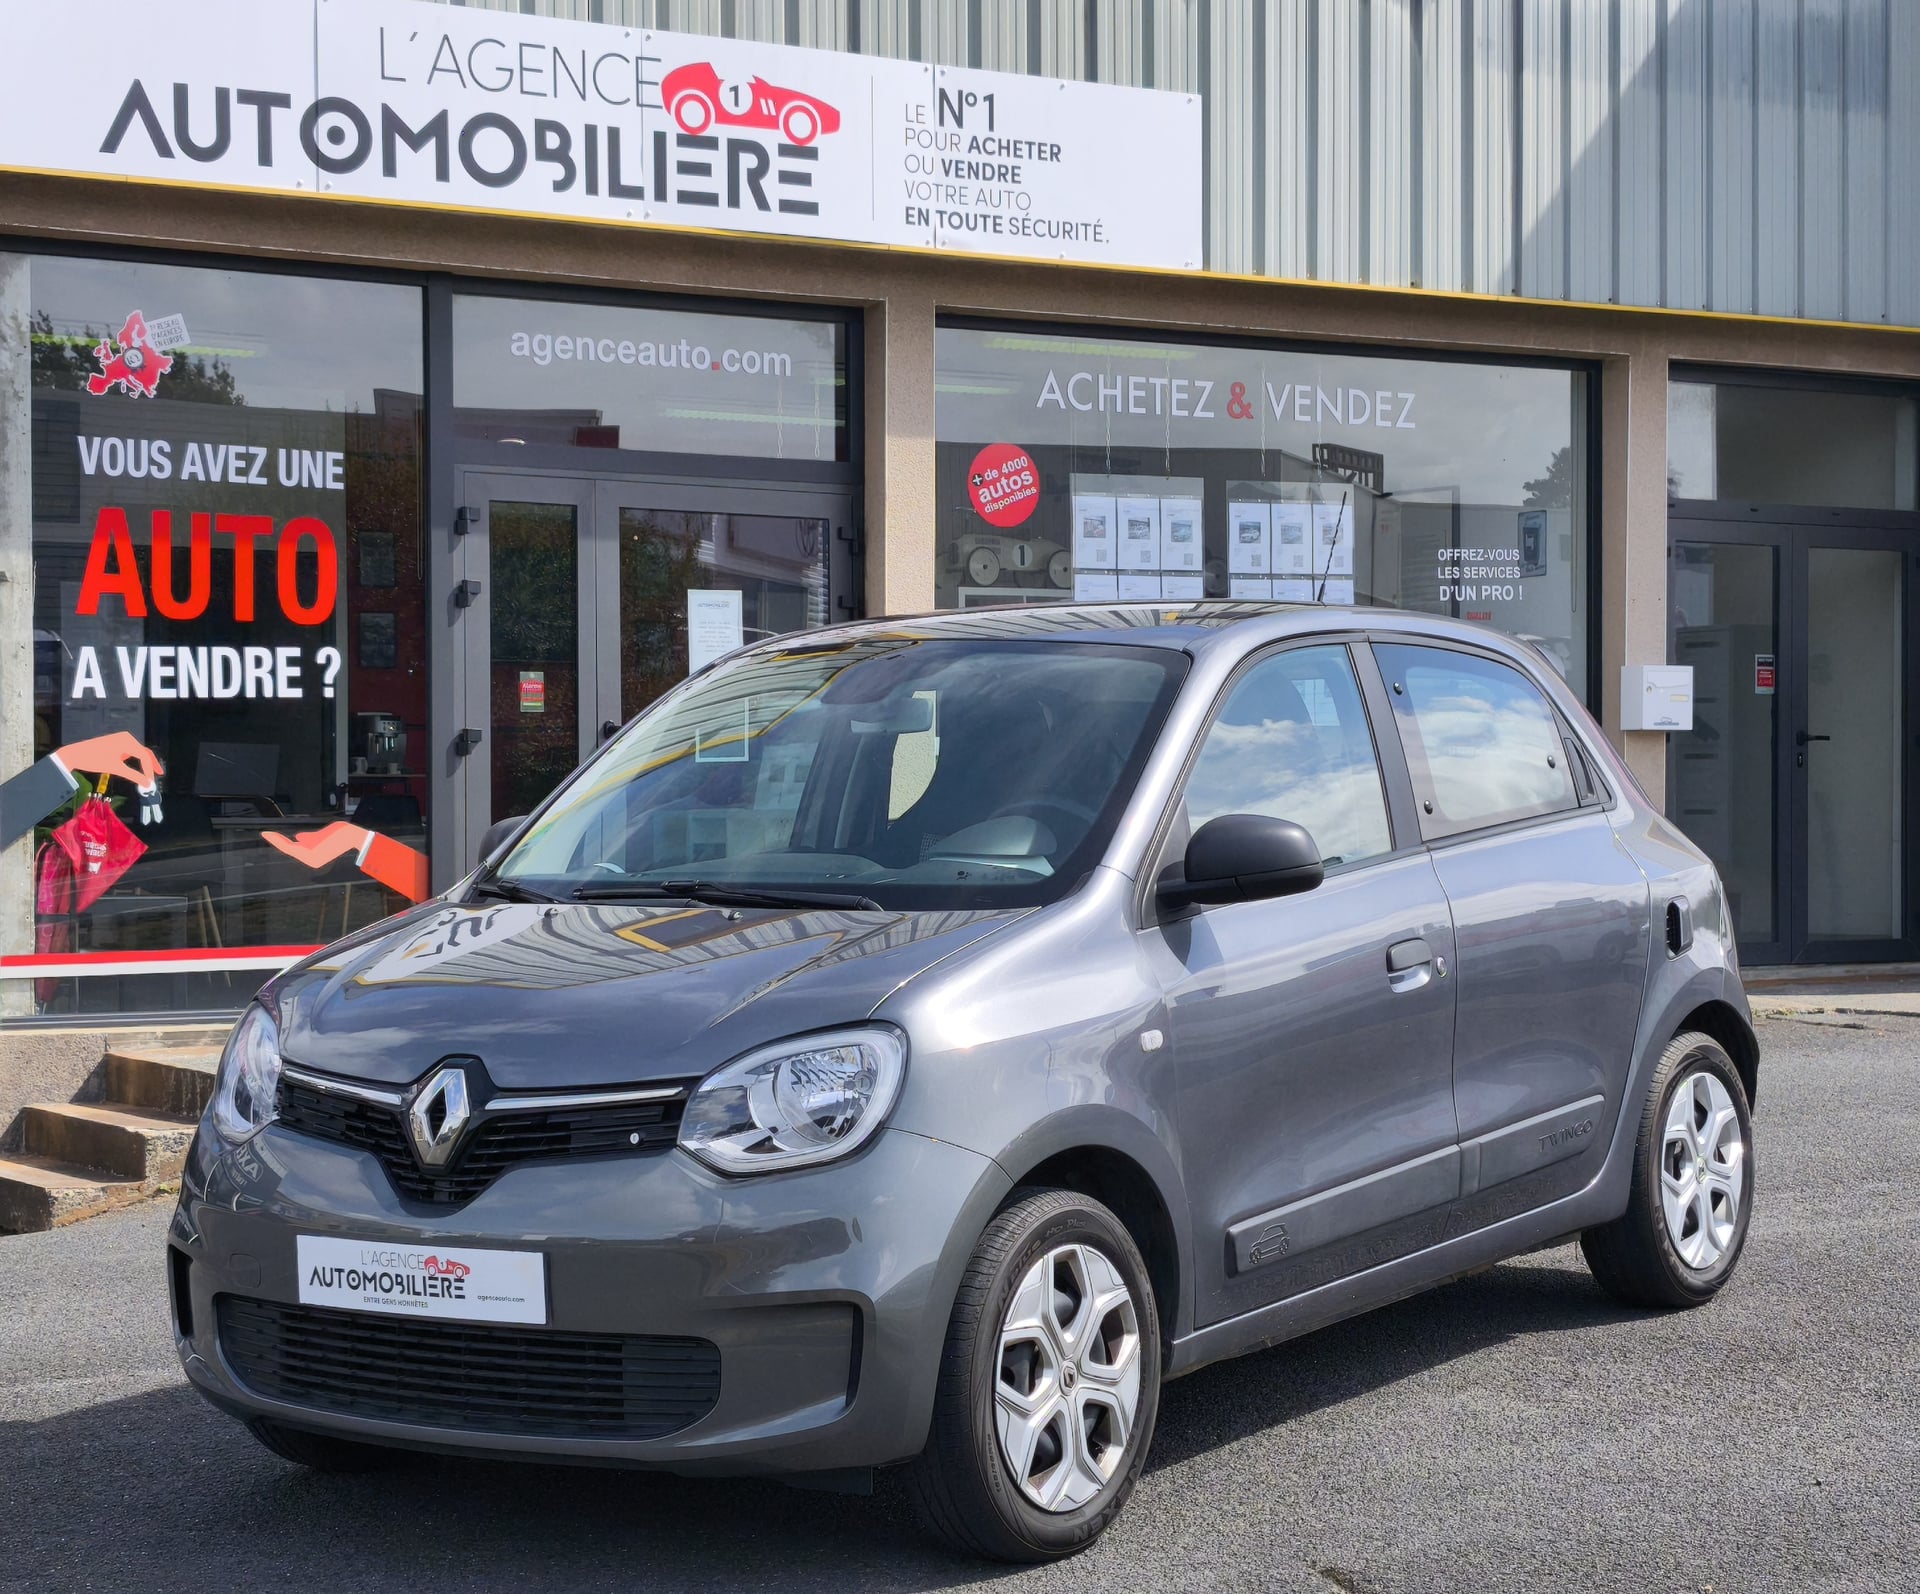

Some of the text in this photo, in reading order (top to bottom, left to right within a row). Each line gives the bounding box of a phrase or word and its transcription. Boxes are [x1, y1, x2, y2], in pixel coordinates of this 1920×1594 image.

[379, 26, 662, 109] L'AGENCE
[904, 102, 926, 125] LE
[904, 128, 1062, 163] POUR ACHETER
[904, 153, 1022, 185] OU VENDRE
[904, 179, 1032, 211] VOTRE AUTO
[904, 205, 1110, 245] EN TOUTE SÉCURITÉ.
[511, 331, 792, 376] agenceauto.com
[1036, 368, 1417, 430] ACHETEZ & VENDEZ
[77, 435, 345, 490] VOUS AVEZ UNE
[984, 468, 999, 481] de
[1001, 455, 1029, 475] 4000
[978, 469, 1034, 504] autos
[984, 486, 1038, 513] disponibles
[75, 505, 339, 626] AUTO
[1437, 548, 1520, 561] OFFREZ-VOUS
[1437, 566, 1521, 579] LES SERVICES
[1439, 584, 1524, 601] D'UN PRO !
[71, 646, 342, 699] A VENDRE ?
[1538, 1118, 1593, 1153] TWINGO
[361, 1249, 424, 1271] L'AGENCE
[363, 1296, 380, 1304] ENTRE
[381, 1298, 397, 1306] GENS
